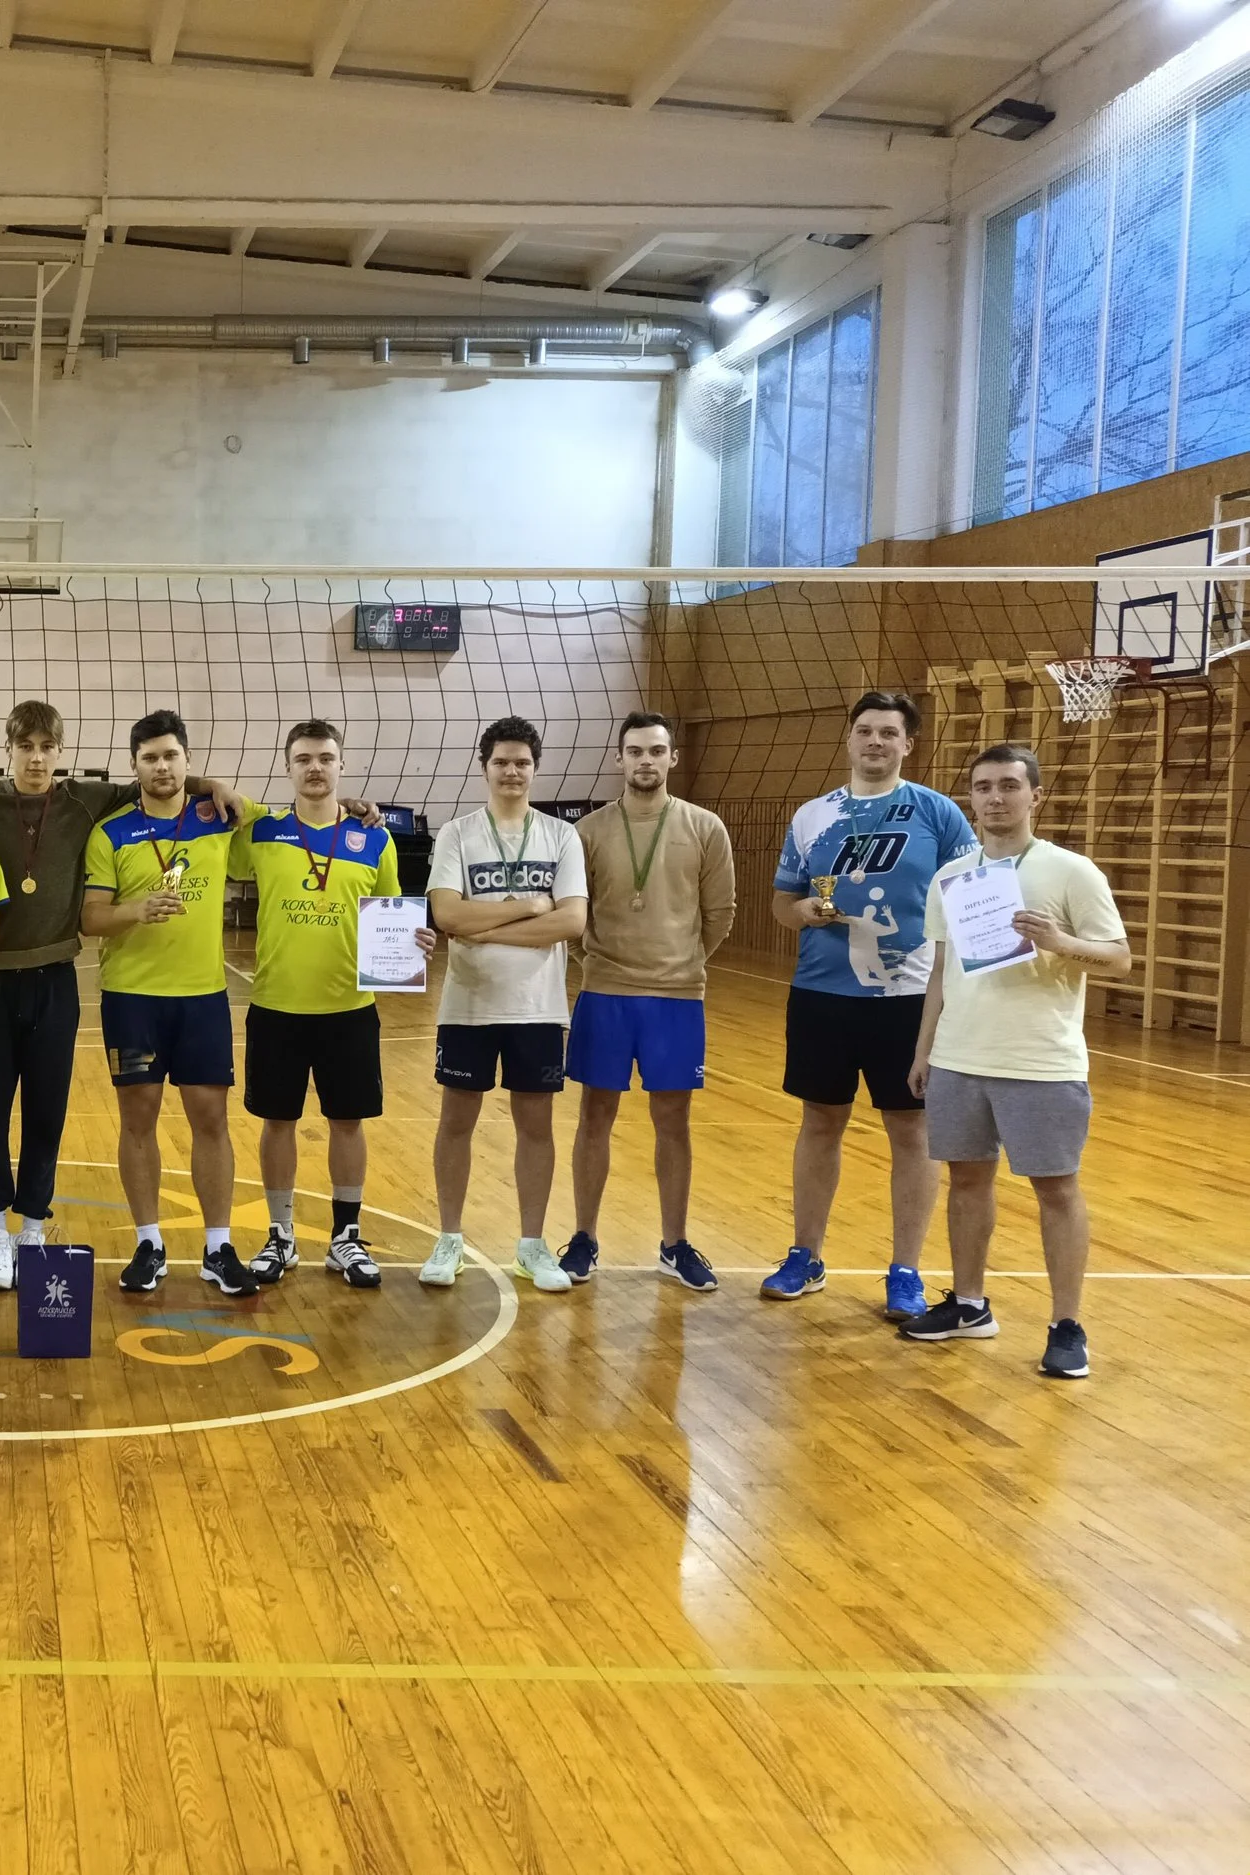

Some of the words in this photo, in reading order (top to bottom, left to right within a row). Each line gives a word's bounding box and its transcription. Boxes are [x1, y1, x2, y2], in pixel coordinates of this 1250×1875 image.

[885, 804, 915, 823] 19
[473, 866, 554, 889] adidas
[286, 913, 340, 927] NOVADS
